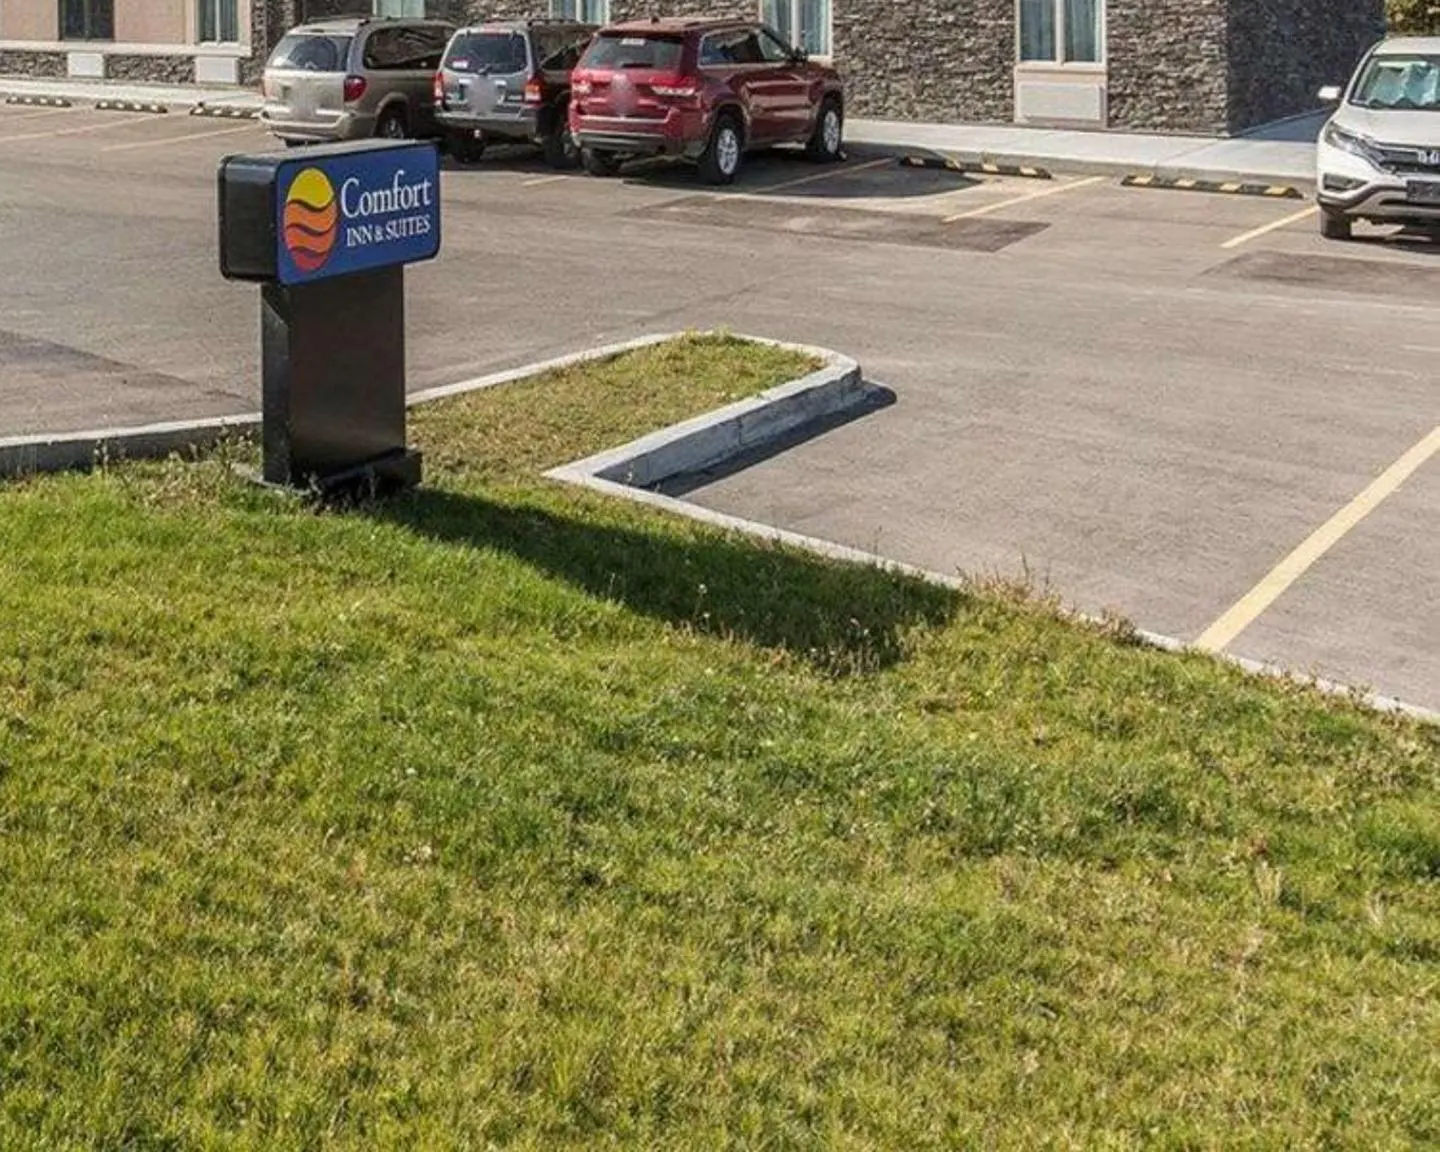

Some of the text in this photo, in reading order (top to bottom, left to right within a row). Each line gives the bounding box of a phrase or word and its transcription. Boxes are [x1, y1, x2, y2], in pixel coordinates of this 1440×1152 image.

[341, 169, 432, 218] Comfort
[346, 214, 431, 247] INN & SUITES
